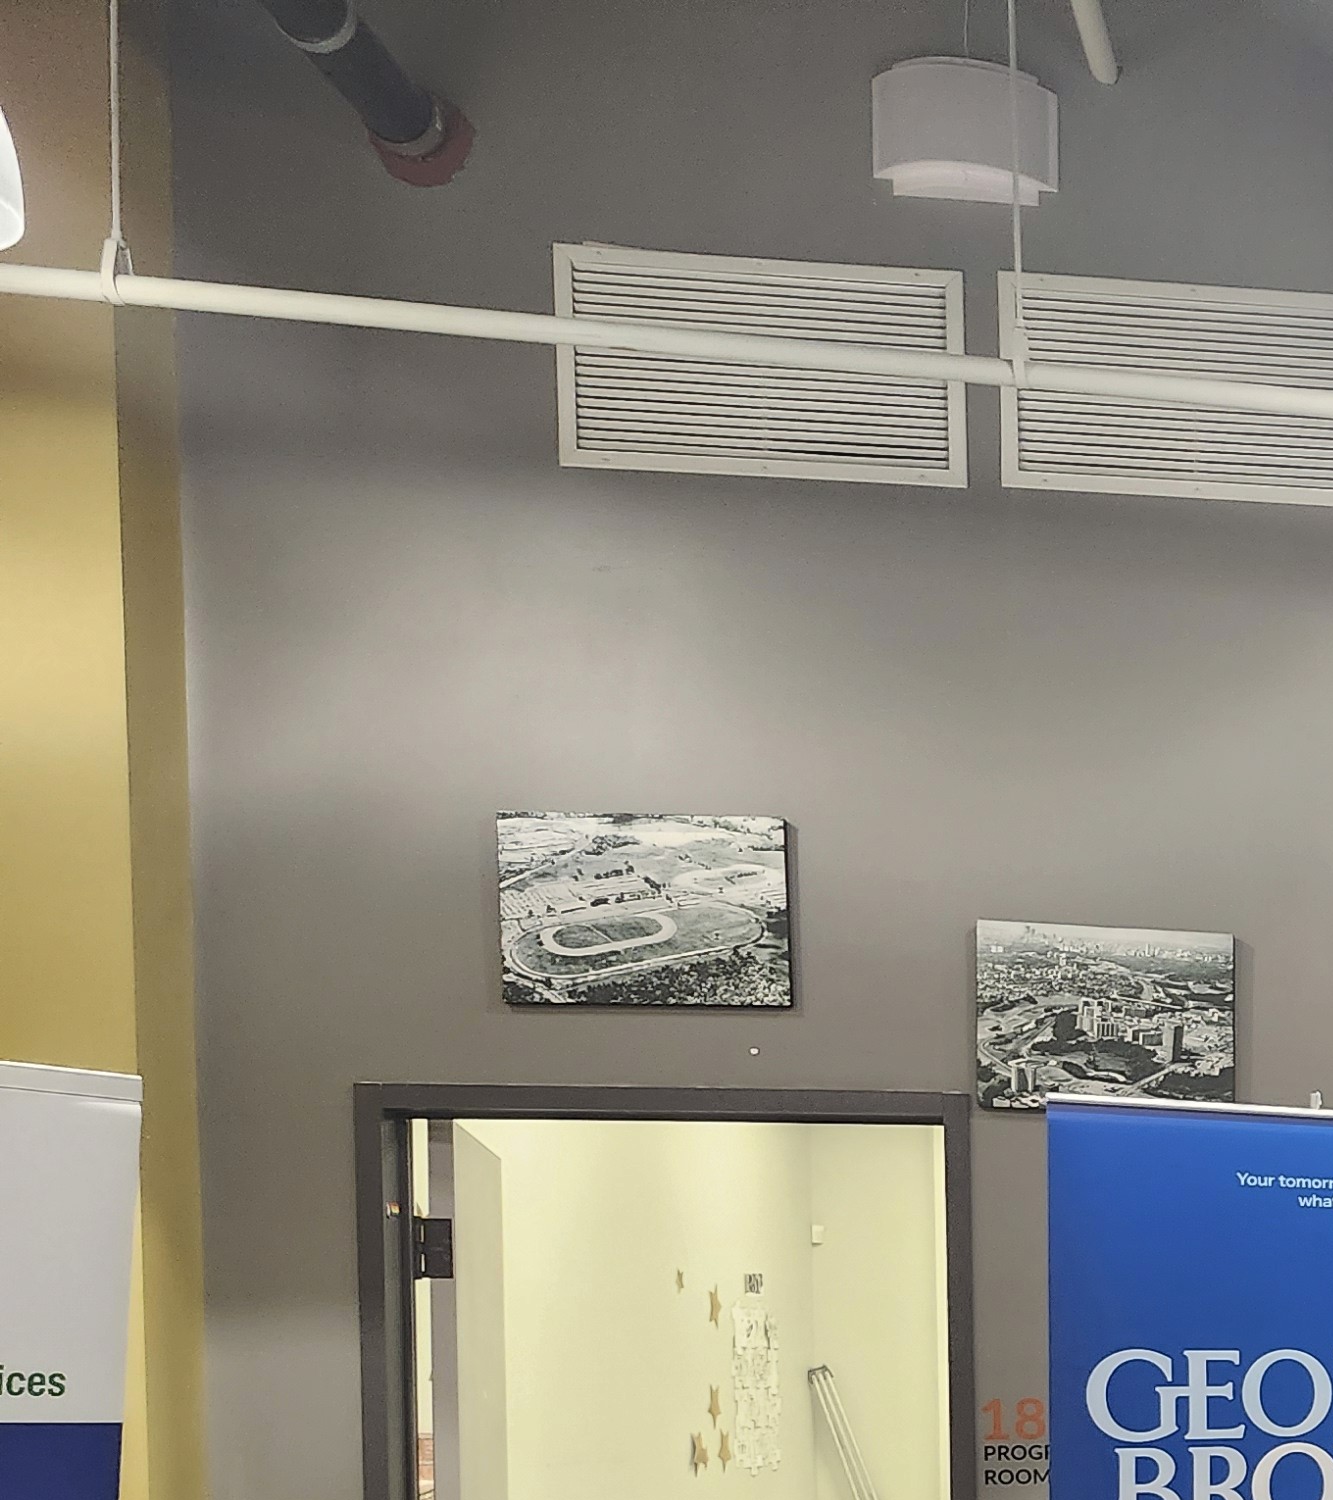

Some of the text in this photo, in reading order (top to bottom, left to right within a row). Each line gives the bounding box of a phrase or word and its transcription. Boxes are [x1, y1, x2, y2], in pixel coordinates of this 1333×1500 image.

[1236, 1172, 1275, 1187] Your
[981, 1397, 1046, 1440] 18
[984, 1469, 1050, 1485] ROOM
